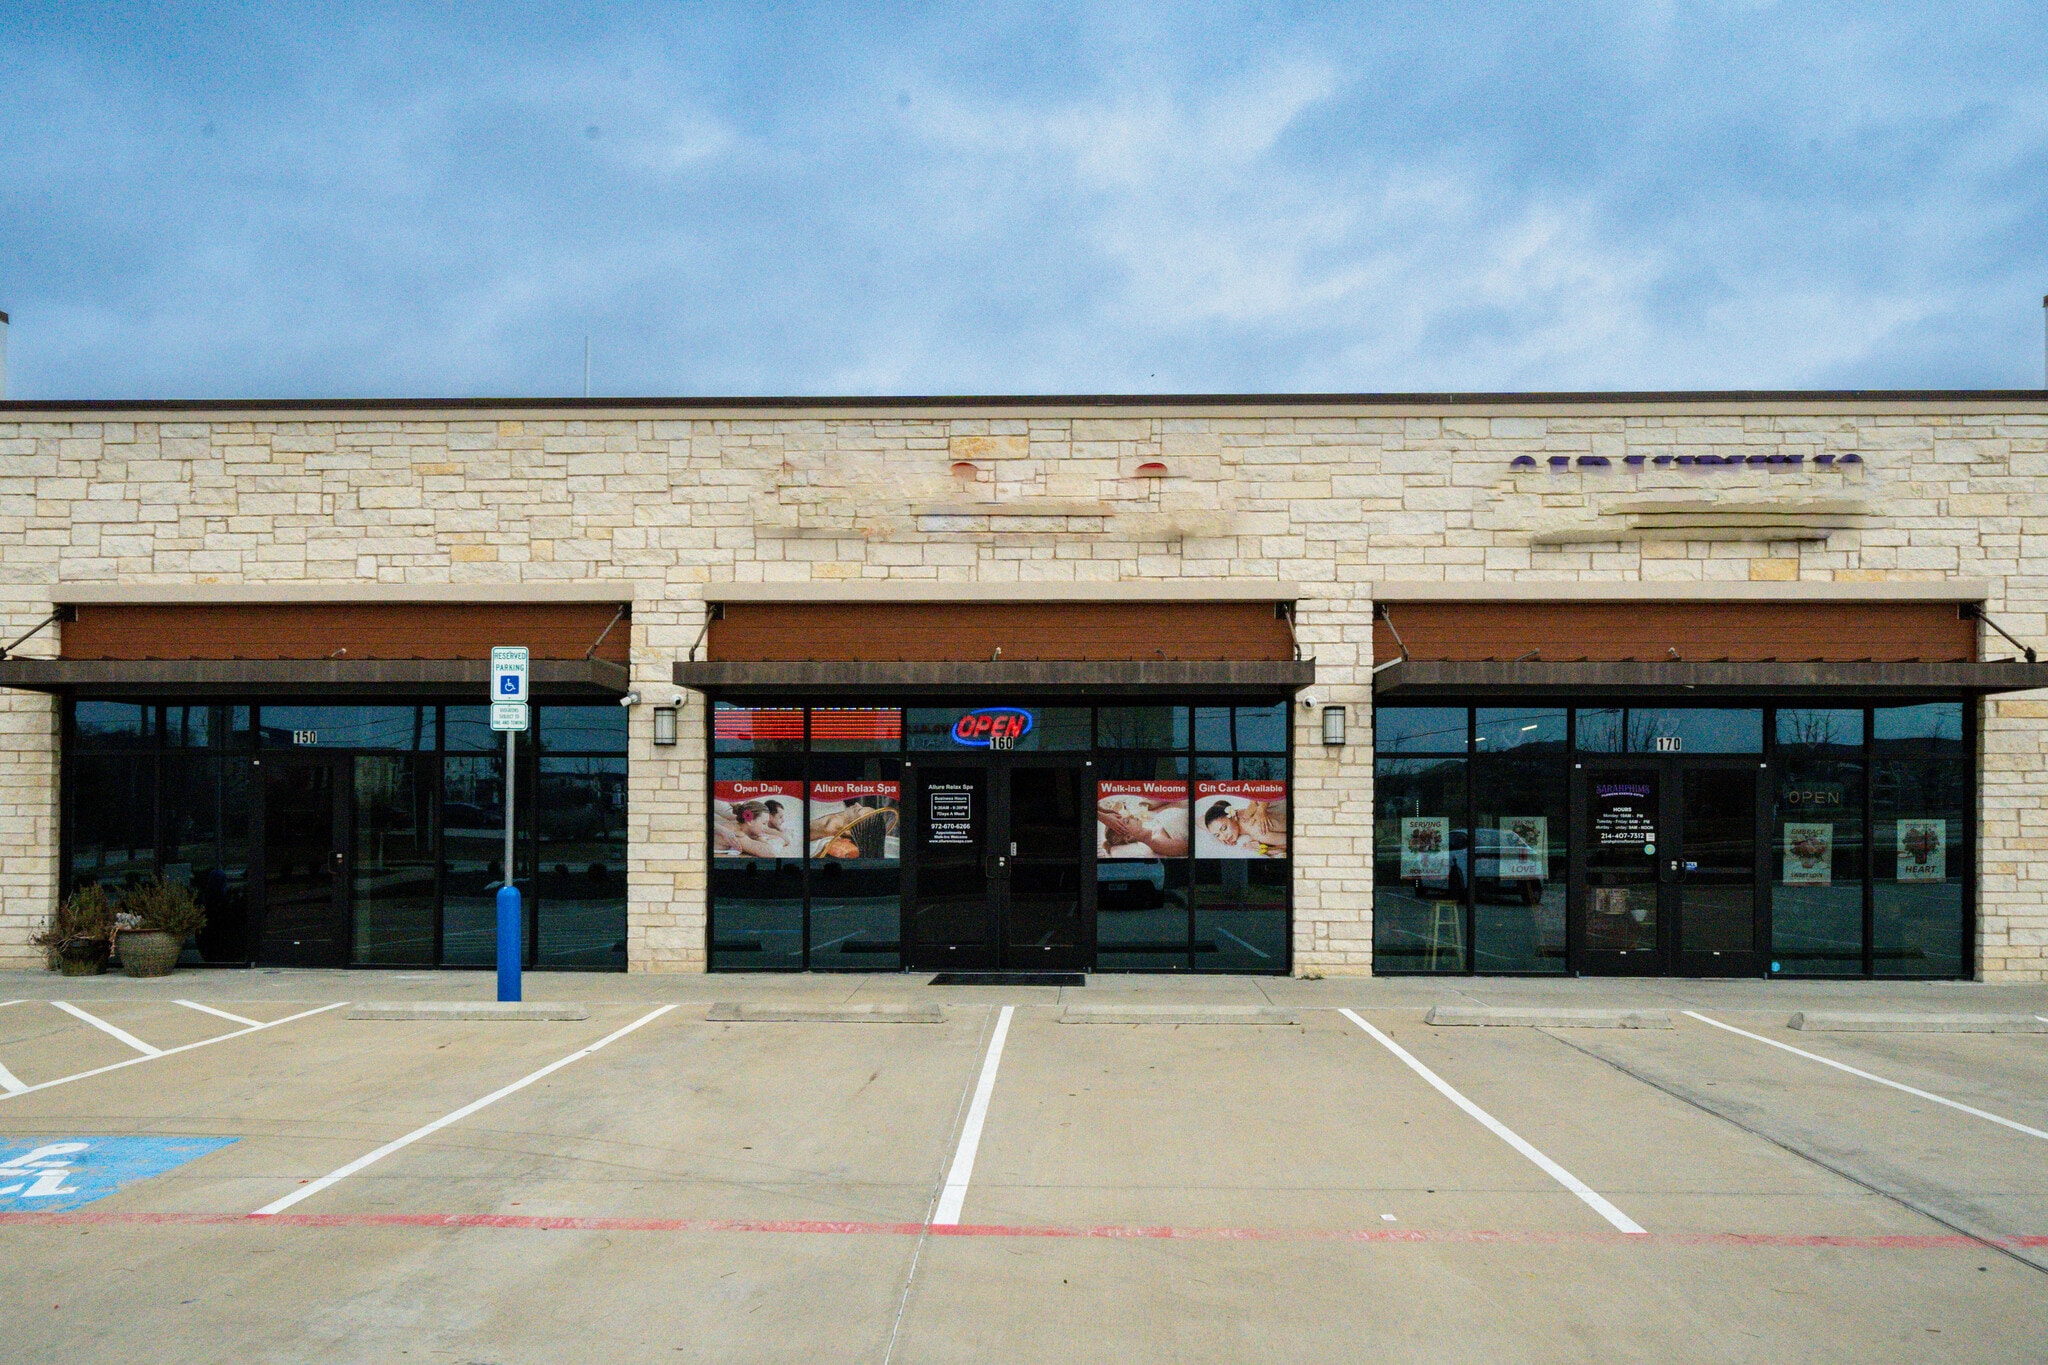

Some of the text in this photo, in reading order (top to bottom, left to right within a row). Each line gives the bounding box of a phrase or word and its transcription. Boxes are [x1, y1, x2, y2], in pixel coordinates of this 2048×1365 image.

[494, 652, 526, 660] RESERVED
[495, 663, 525, 672] PARKING
[957, 715, 1025, 739] OPEN
[295, 731, 316, 744] 150
[991, 736, 1013, 749] 160
[1658, 737, 1681, 751] 170
[733, 783, 783, 794] Open Daily
[814, 783, 897, 795] Allure Relax Spa
[1101, 782, 1186, 793] Walk-ins Welcome
[1198, 783, 1283, 793] Gift Card Available
[1596, 783, 1650, 795] SARAHPHIMS
[1788, 790, 1840, 804] OPEN
[1511, 865, 1537, 873] LOVE
[1905, 865, 1937, 873] HEART
